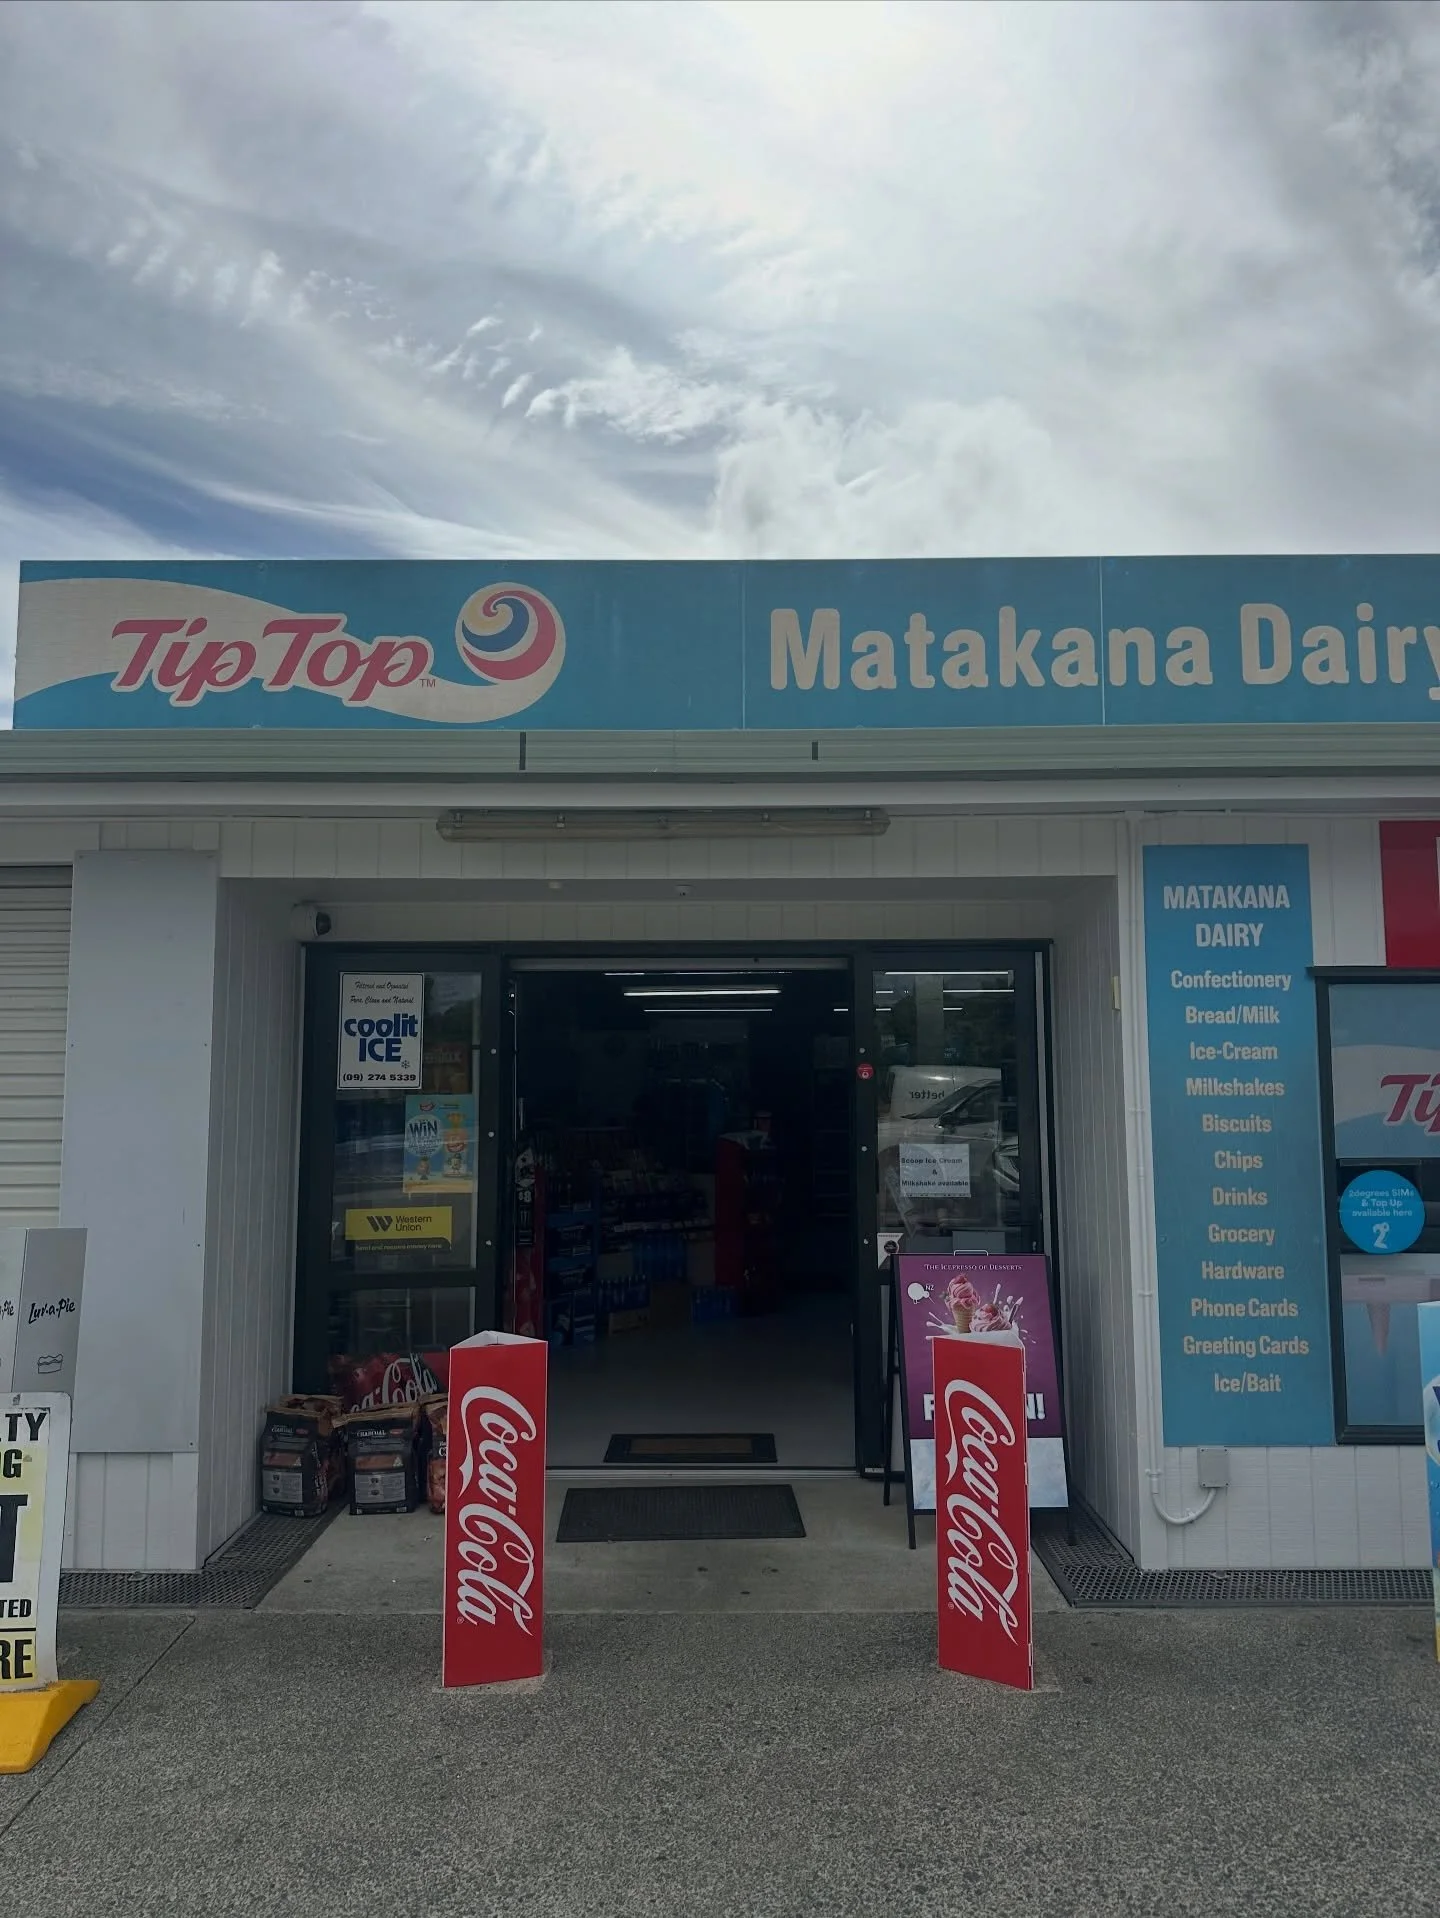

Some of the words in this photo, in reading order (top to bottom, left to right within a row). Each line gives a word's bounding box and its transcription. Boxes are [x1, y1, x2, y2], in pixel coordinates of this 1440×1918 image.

[770, 606, 1213, 690] Matakana
[111, 617, 256, 702] Tip
[263, 618, 428, 702] Top
[1163, 885, 1290, 909] MATAKANA
[1195, 923, 1264, 947] DAIRY
[1171, 970, 1292, 991] Confectionery
[344, 1013, 418, 1037] coolit
[1185, 1005, 1280, 1025] Bread/Milk
[359, 1038, 402, 1062] ICE
[1190, 1041, 1278, 1060] Ice-Cream
[343, 1073, 363, 1083] (09)
[368, 1074, 386, 1082] 274
[389, 1074, 416, 1082] 5339
[1186, 1078, 1285, 1096] Milkshakes
[1202, 1114, 1272, 1133] Biscuits
[1214, 1150, 1263, 1172] Chips
[1212, 1187, 1268, 1206] Drinks
[1372, 1199, 1387, 1208] Top
[1390, 1199, 1403, 1208] Up
[396, 1215, 432, 1224] Western
[1352, 1208, 1391, 1217] available
[1393, 1208, 1413, 1217] here
[395, 1223, 422, 1232] Union
[1208, 1223, 1275, 1246] Grocery
[1202, 1260, 1284, 1280] Hardware
[1191, 1298, 1246, 1317] Phone
[1248, 1298, 1299, 1317] Cards
[1183, 1335, 1257, 1358] Greeting
[1259, 1335, 1309, 1354] Cards
[1214, 1371, 1282, 1393] Ice/Bait
[458, 1386, 537, 1637] Coca-Cola
[945, 1379, 1018, 1645] Coca-Cola
